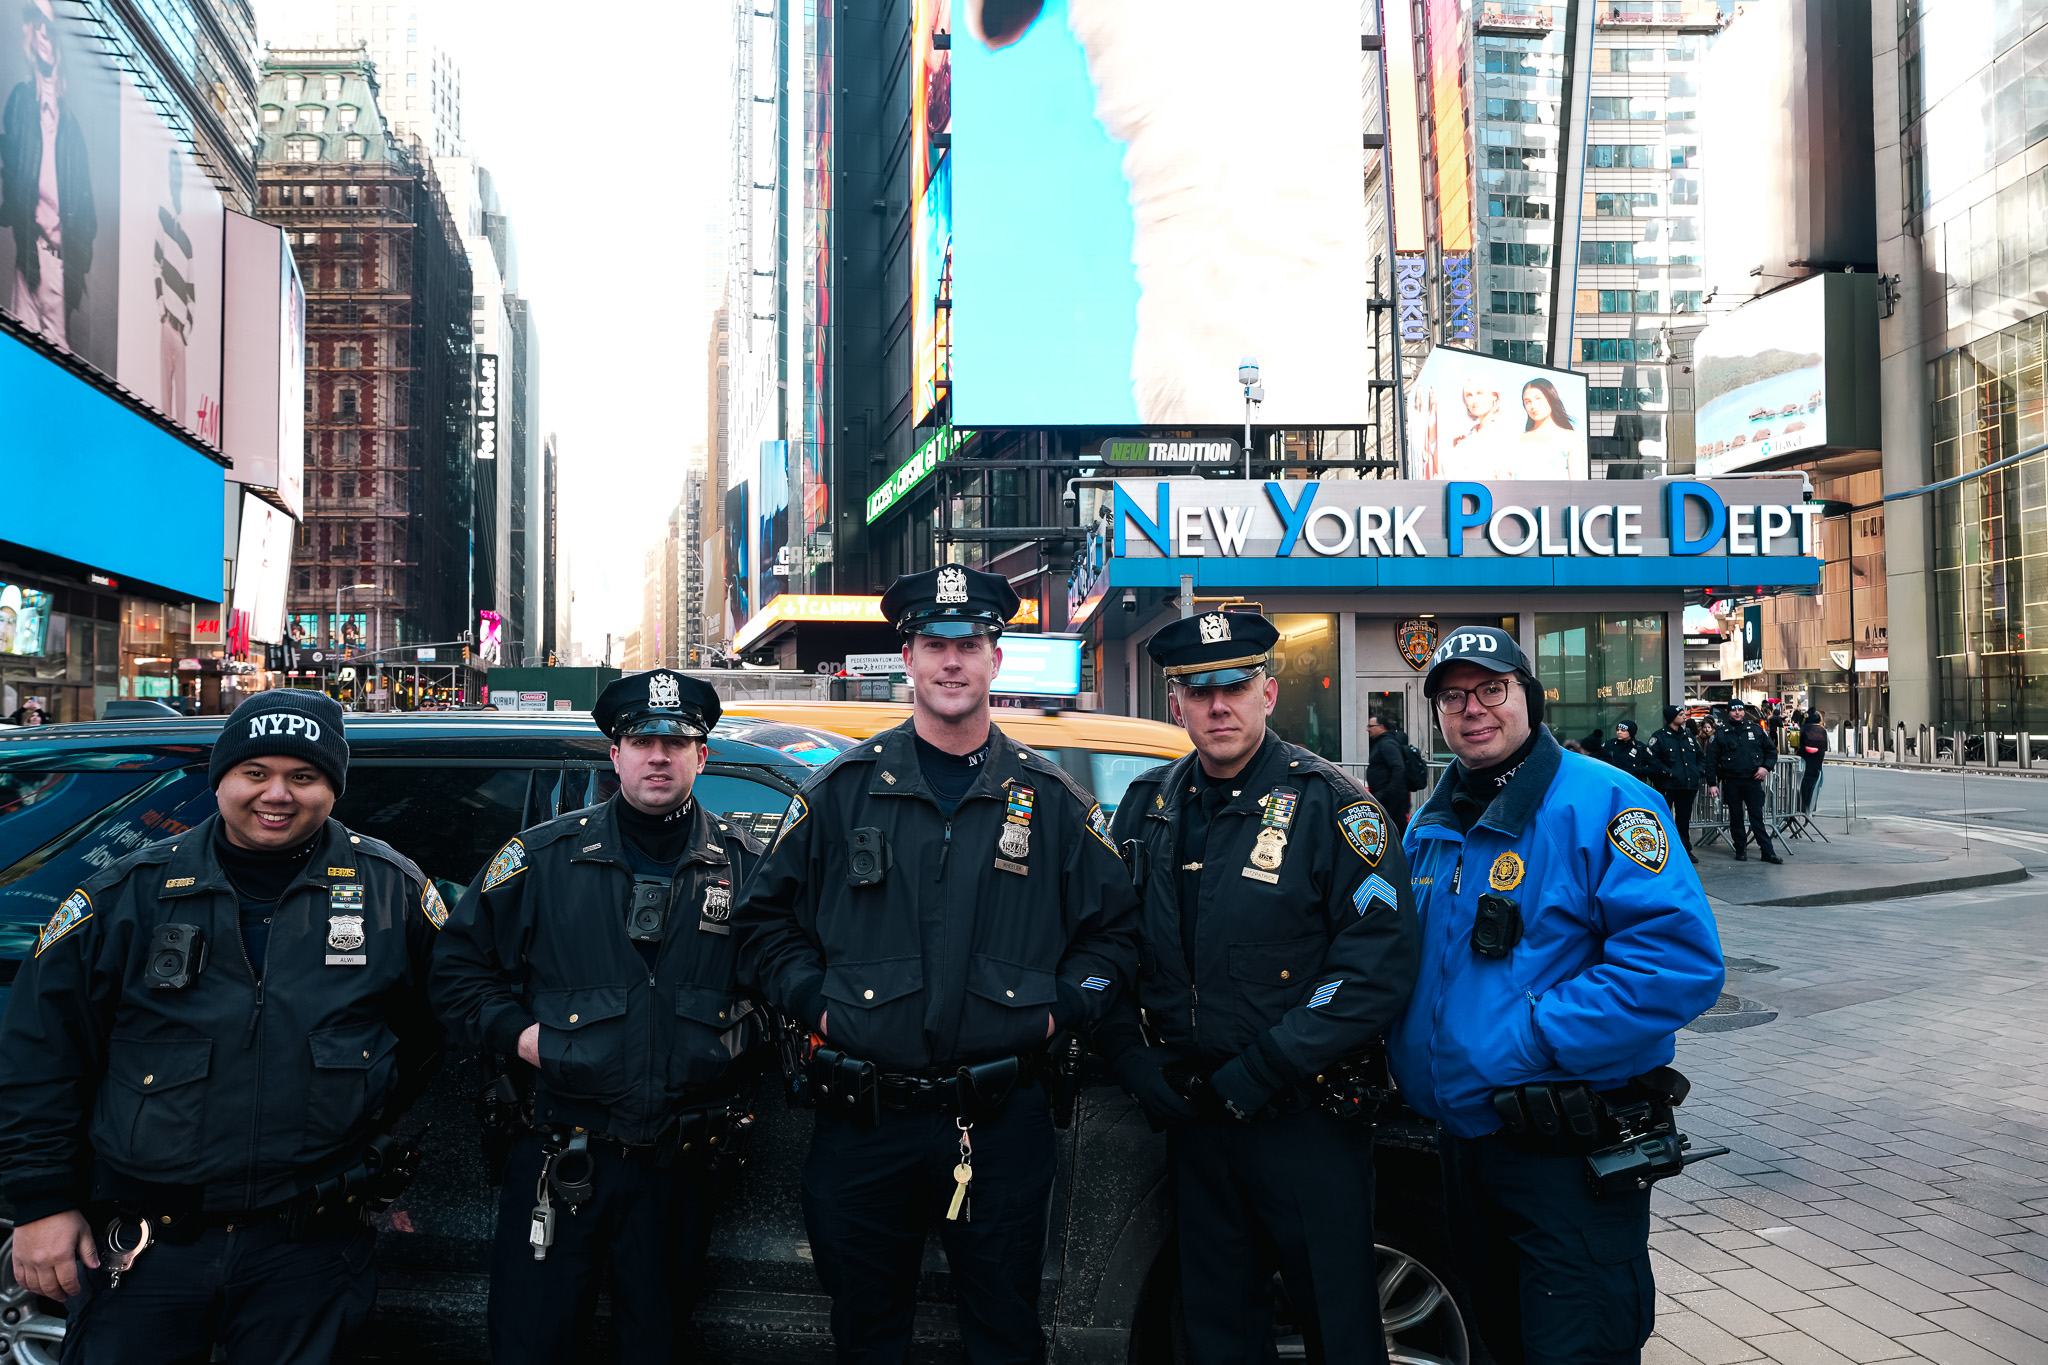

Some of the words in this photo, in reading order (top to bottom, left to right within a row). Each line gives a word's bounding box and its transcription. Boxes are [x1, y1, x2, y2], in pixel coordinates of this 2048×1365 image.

[477, 358, 496, 417] Locker
[196, 393, 220, 444] H&M
[477, 421, 496, 459] Foot
[1114, 480, 1256, 558] NEW
[1265, 482, 1428, 557] YORK
[1446, 481, 1643, 556] POLICE
[1667, 481, 1824, 556] DEPT
[808, 601, 862, 616] CANDY
[196, 619, 220, 633] H&M
[1400, 626, 1437, 635] DEPARTMENT
[1434, 633, 1498, 666] NYPD
[493, 696, 515, 706] SUBWAY
[249, 713, 321, 742] NYPD
[1343, 812, 1380, 825] DEPARTMENT
[1348, 805, 1372, 815] POLICE
[1619, 812, 1646, 824] POLICE
[1614, 818, 1657, 836] DEPARTMENT
[1347, 831, 1360, 847] CITY
[1619, 841, 1636, 854] CITY
[1635, 854, 1647, 862] OF
[1657, 848, 1666, 863] NEW
